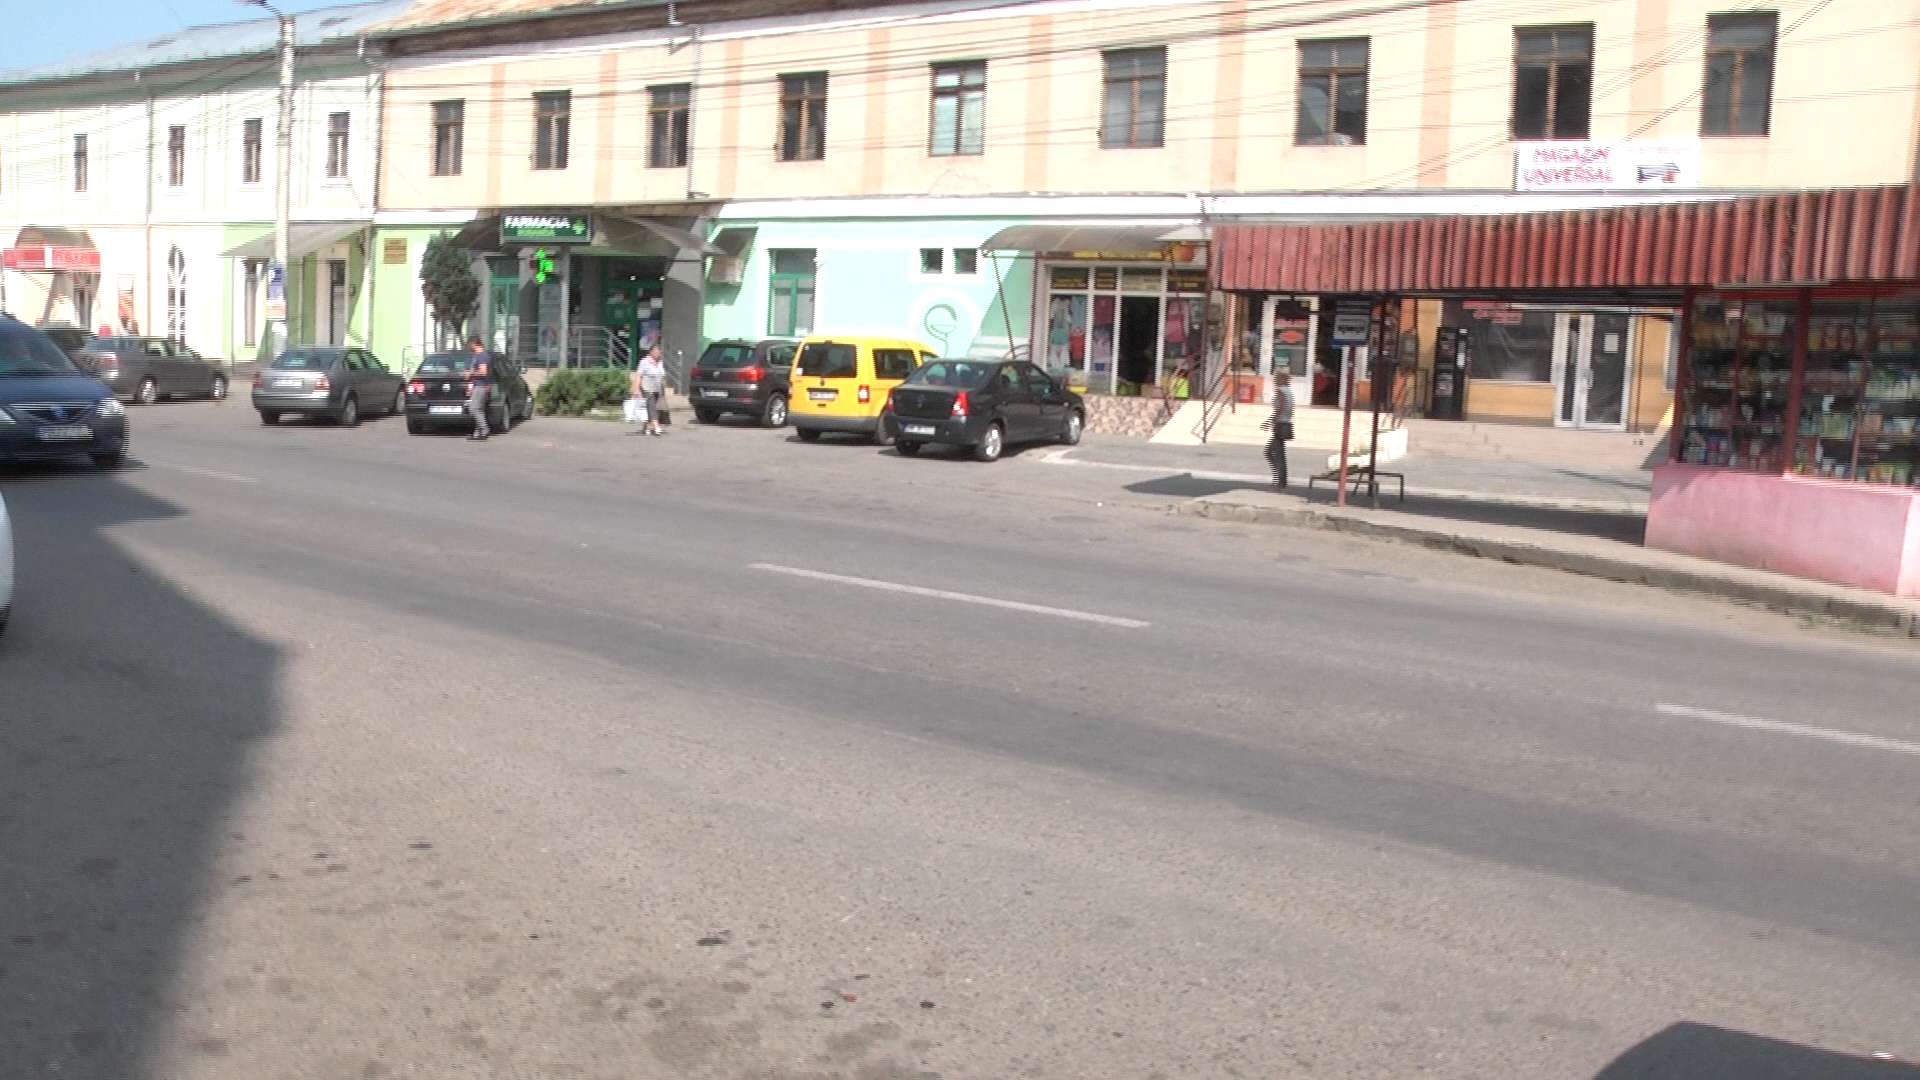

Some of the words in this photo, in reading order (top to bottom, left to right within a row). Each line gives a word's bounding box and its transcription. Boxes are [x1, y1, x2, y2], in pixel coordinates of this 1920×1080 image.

[1533, 147, 1612, 164] MAGAZIN
[1523, 166, 1615, 184] UNIVERSAL
[504, 215, 571, 228] FARMACIA
